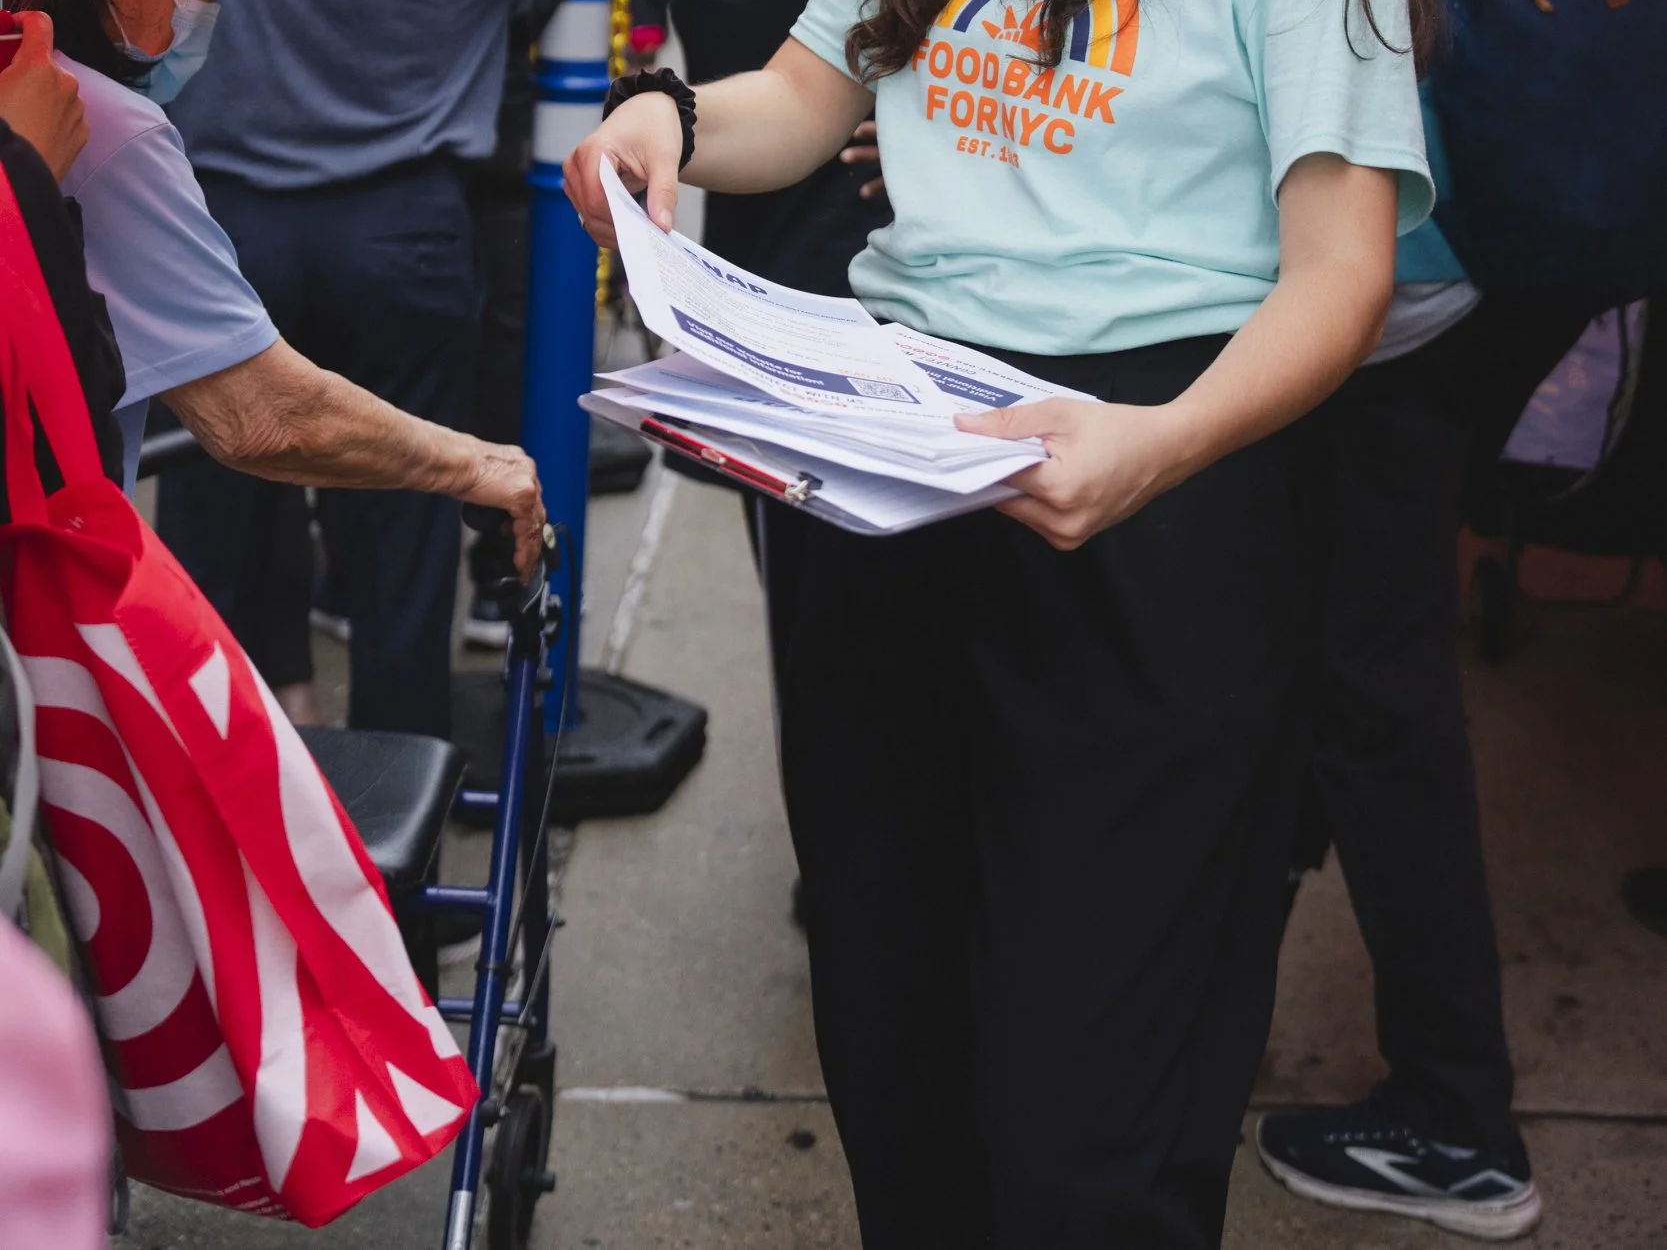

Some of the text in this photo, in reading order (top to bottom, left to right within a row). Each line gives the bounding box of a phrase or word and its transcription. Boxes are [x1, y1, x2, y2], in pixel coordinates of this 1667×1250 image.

[911, 37, 1125, 124] FOOD BANK
[925, 83, 1076, 156] FOR NYC
[942, 375, 1005, 398] additional
[968, 390, 997, 402] Visit
